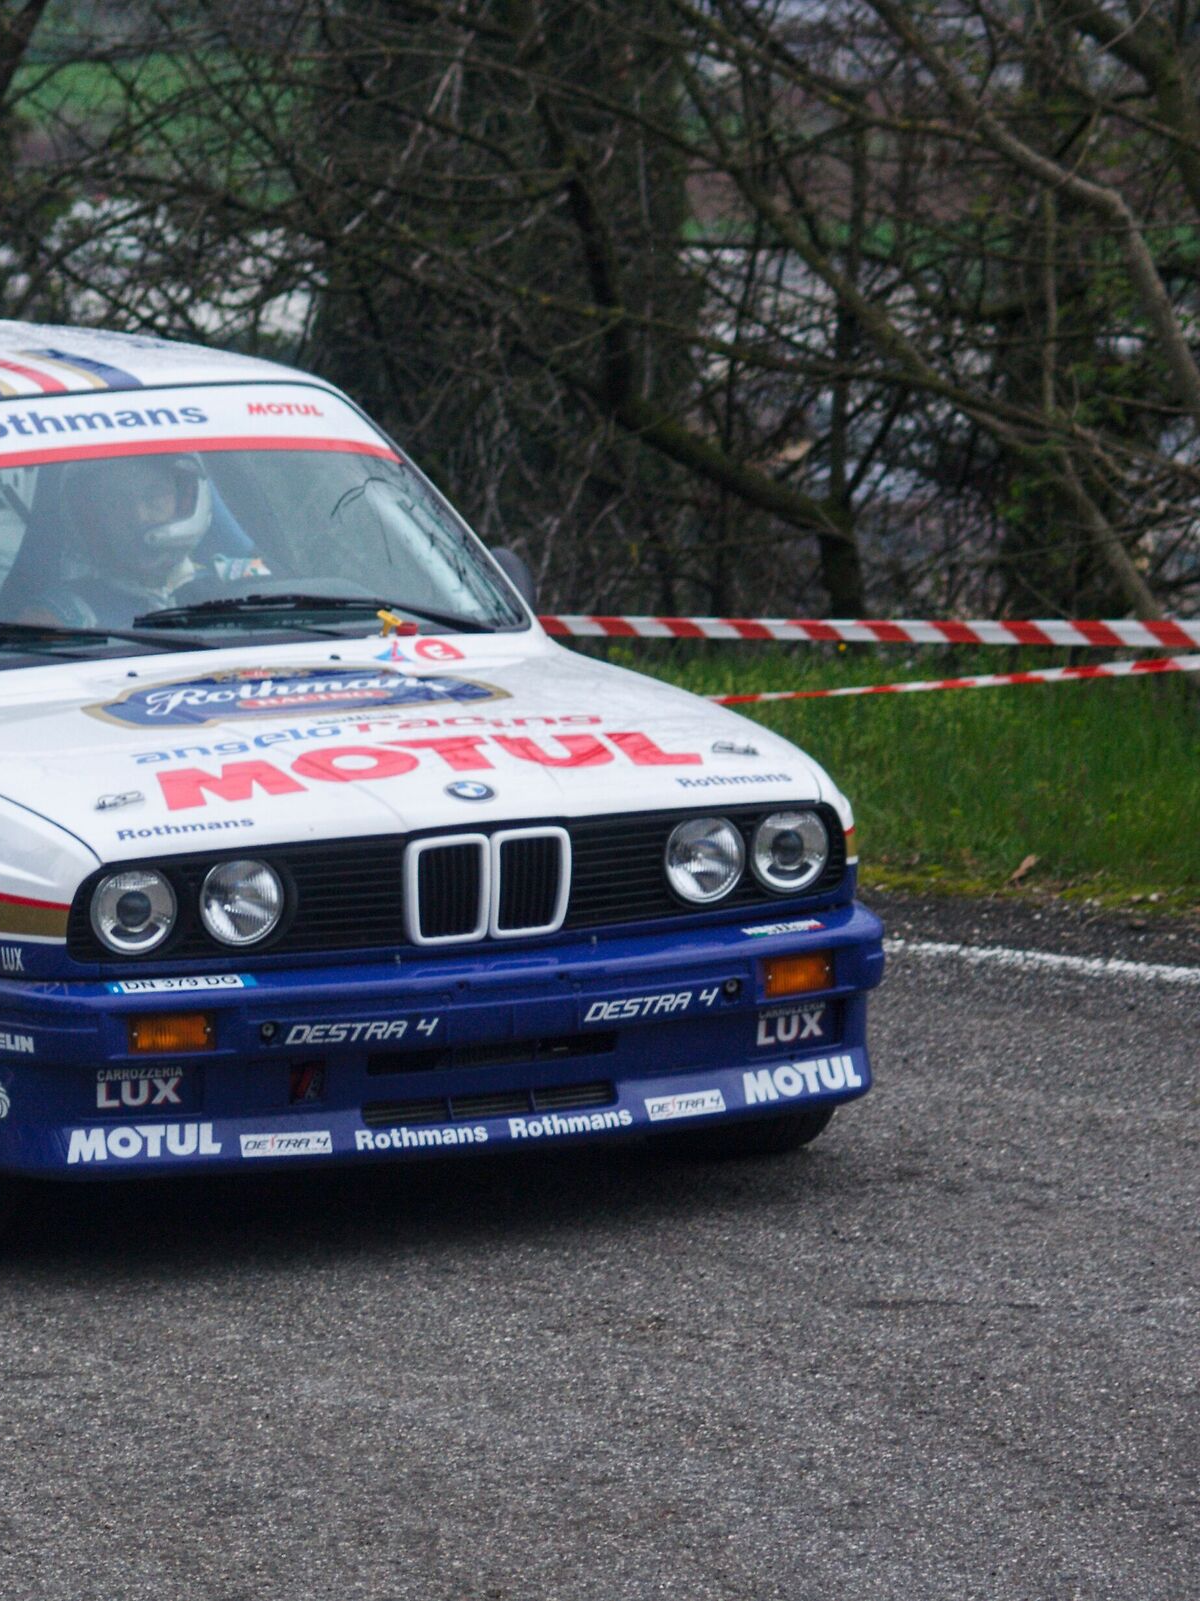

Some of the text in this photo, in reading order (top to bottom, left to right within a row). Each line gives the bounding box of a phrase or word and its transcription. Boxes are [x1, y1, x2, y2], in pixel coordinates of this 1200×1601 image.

[247, 402, 323, 417] MOTUL
[146, 673, 450, 715] Rothmans
[156, 732, 703, 811] MOTUL
[675, 772, 792, 789] Rothmans
[117, 816, 255, 840] Rothmans
[1, 946, 25, 972] LUX
[584, 987, 718, 1022] DESTRA 4
[285, 1017, 439, 1045] DESTRA 4
[756, 1010, 823, 1046] LUX
[96, 1066, 183, 1082] CARROZZERIA
[743, 1055, 862, 1105] MOTUL
[96, 1077, 182, 1108] LUX
[650, 1096, 722, 1116] DESTRA 4
[354, 1125, 488, 1150] Rothmans
[508, 1109, 632, 1139] Rothmans
[67, 1123, 223, 1164] MOTUL
[244, 1136, 329, 1150] DESTRA 4
